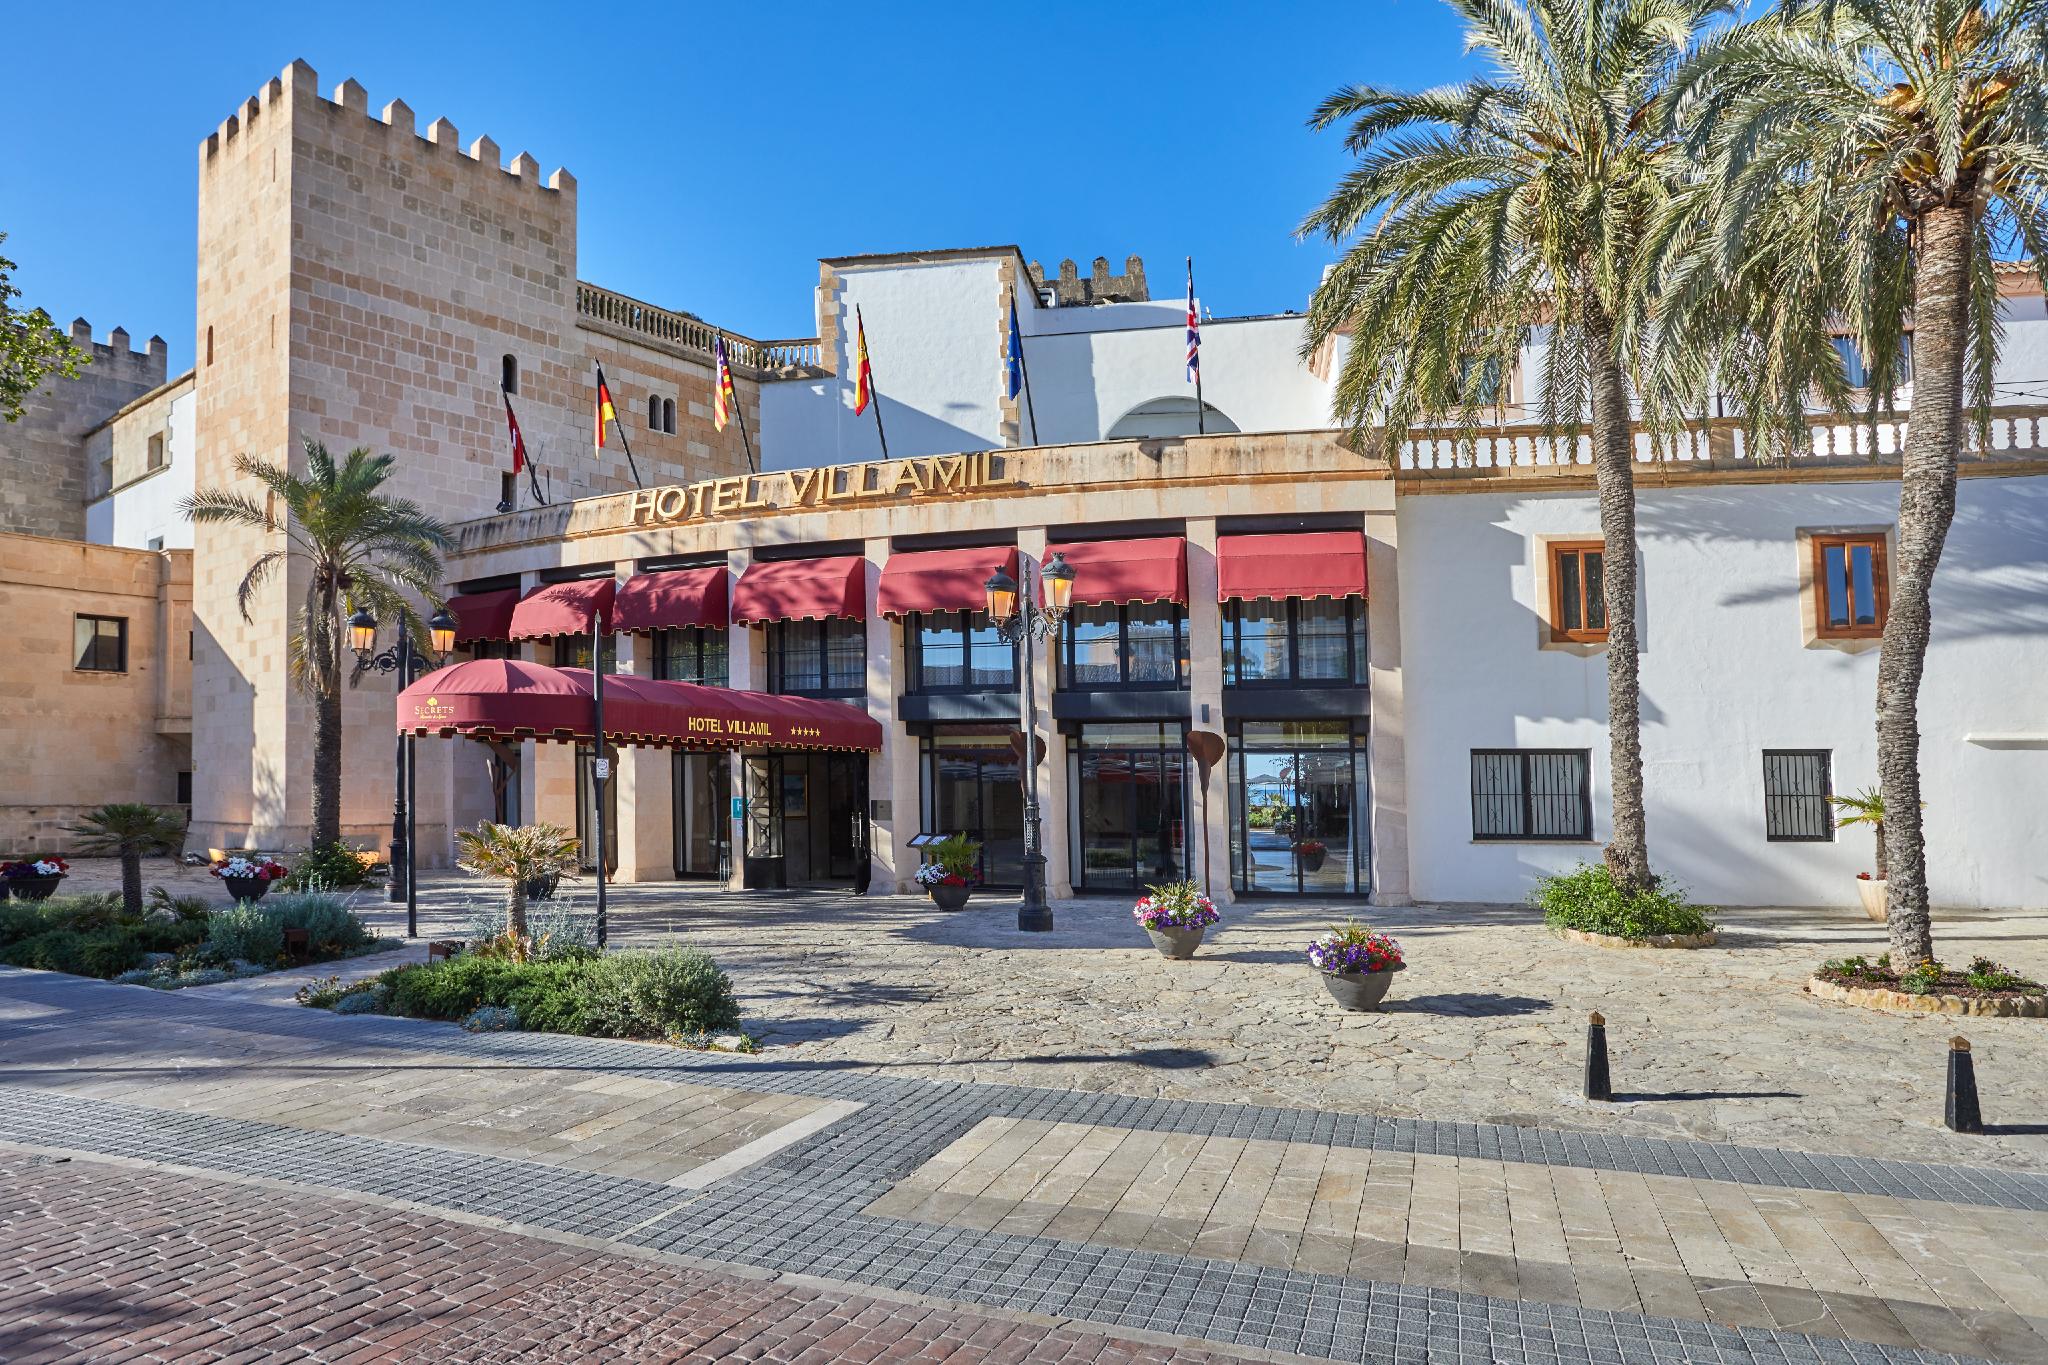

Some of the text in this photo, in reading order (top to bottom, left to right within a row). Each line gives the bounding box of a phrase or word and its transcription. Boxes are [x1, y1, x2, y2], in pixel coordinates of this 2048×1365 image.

[629, 452, 1014, 524] HOTEL VILLAMIL
[688, 716, 772, 736] HOTEL VILLAMIL
